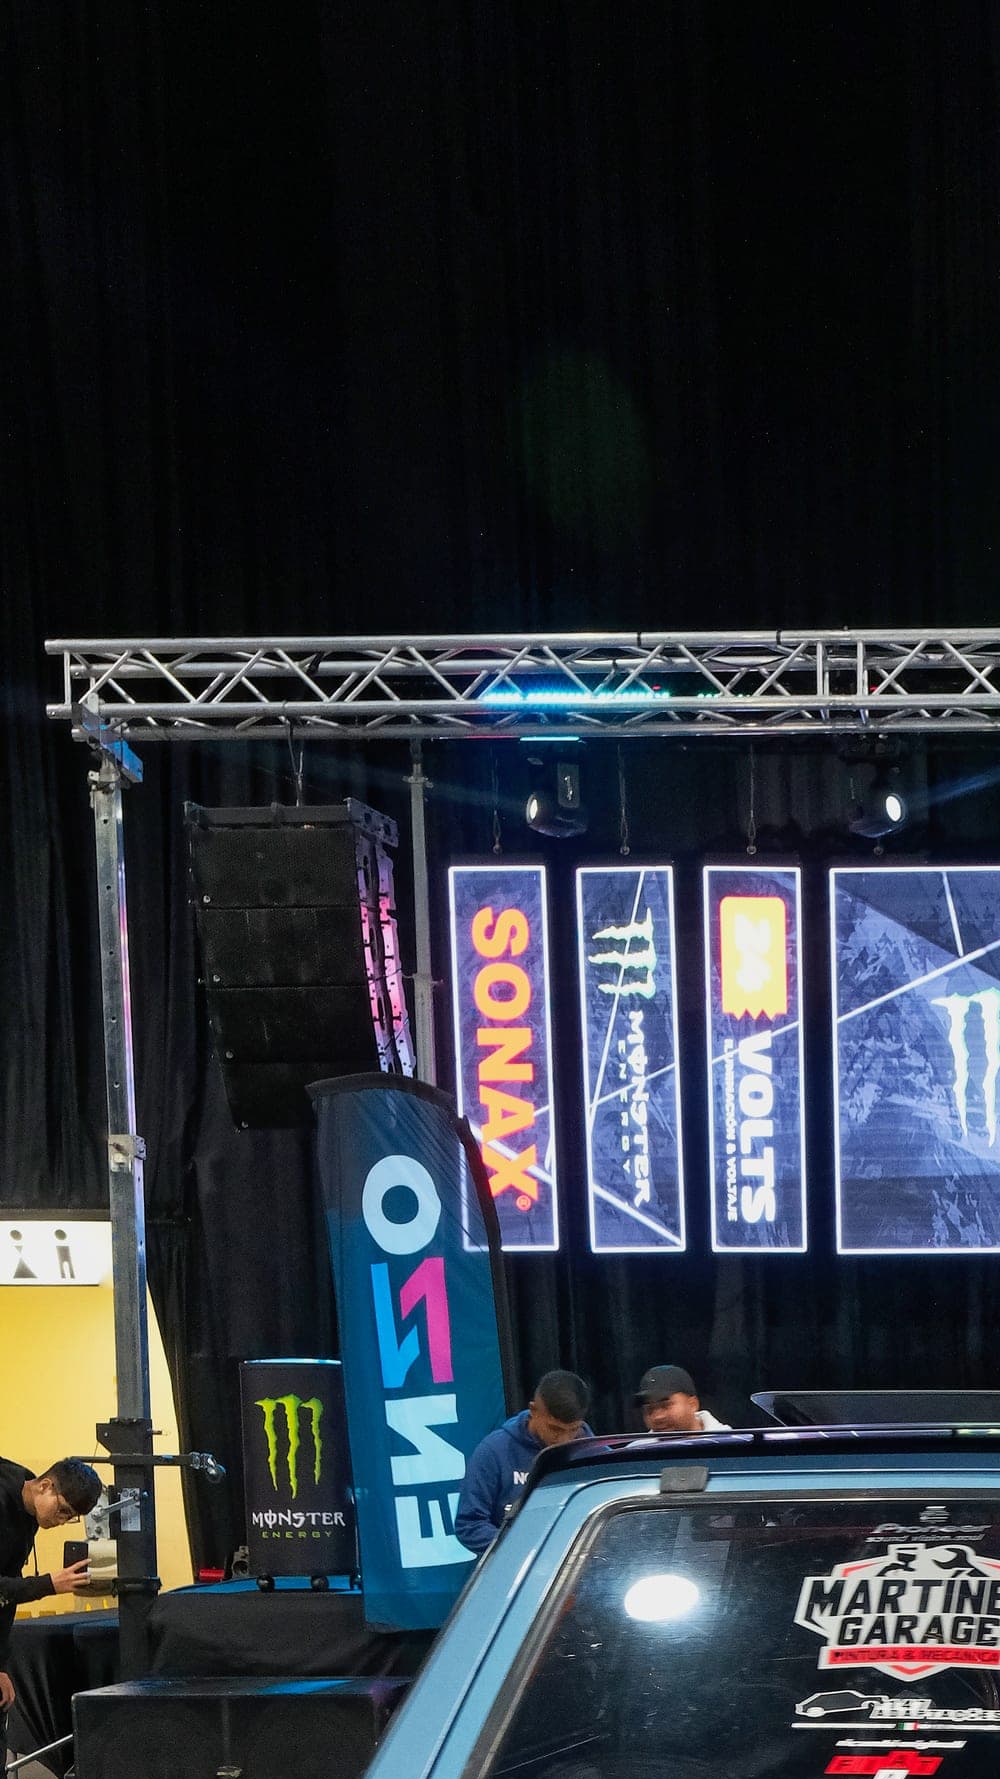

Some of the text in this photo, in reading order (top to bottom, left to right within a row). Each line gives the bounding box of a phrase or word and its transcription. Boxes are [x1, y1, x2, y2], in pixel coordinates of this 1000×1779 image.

[626, 1010, 652, 1208] MONSTER
[738, 1030, 777, 1224] VOLTS
[726, 1158, 737, 1221] VOLTAJE
[252, 1509, 346, 1529] MONSTER
[871, 1523, 992, 1534] Pioneer
[261, 1531, 334, 1540] ENERGY
[837, 1615, 1000, 1647] GARAGE
[834, 1650, 898, 1661] PINTURA
